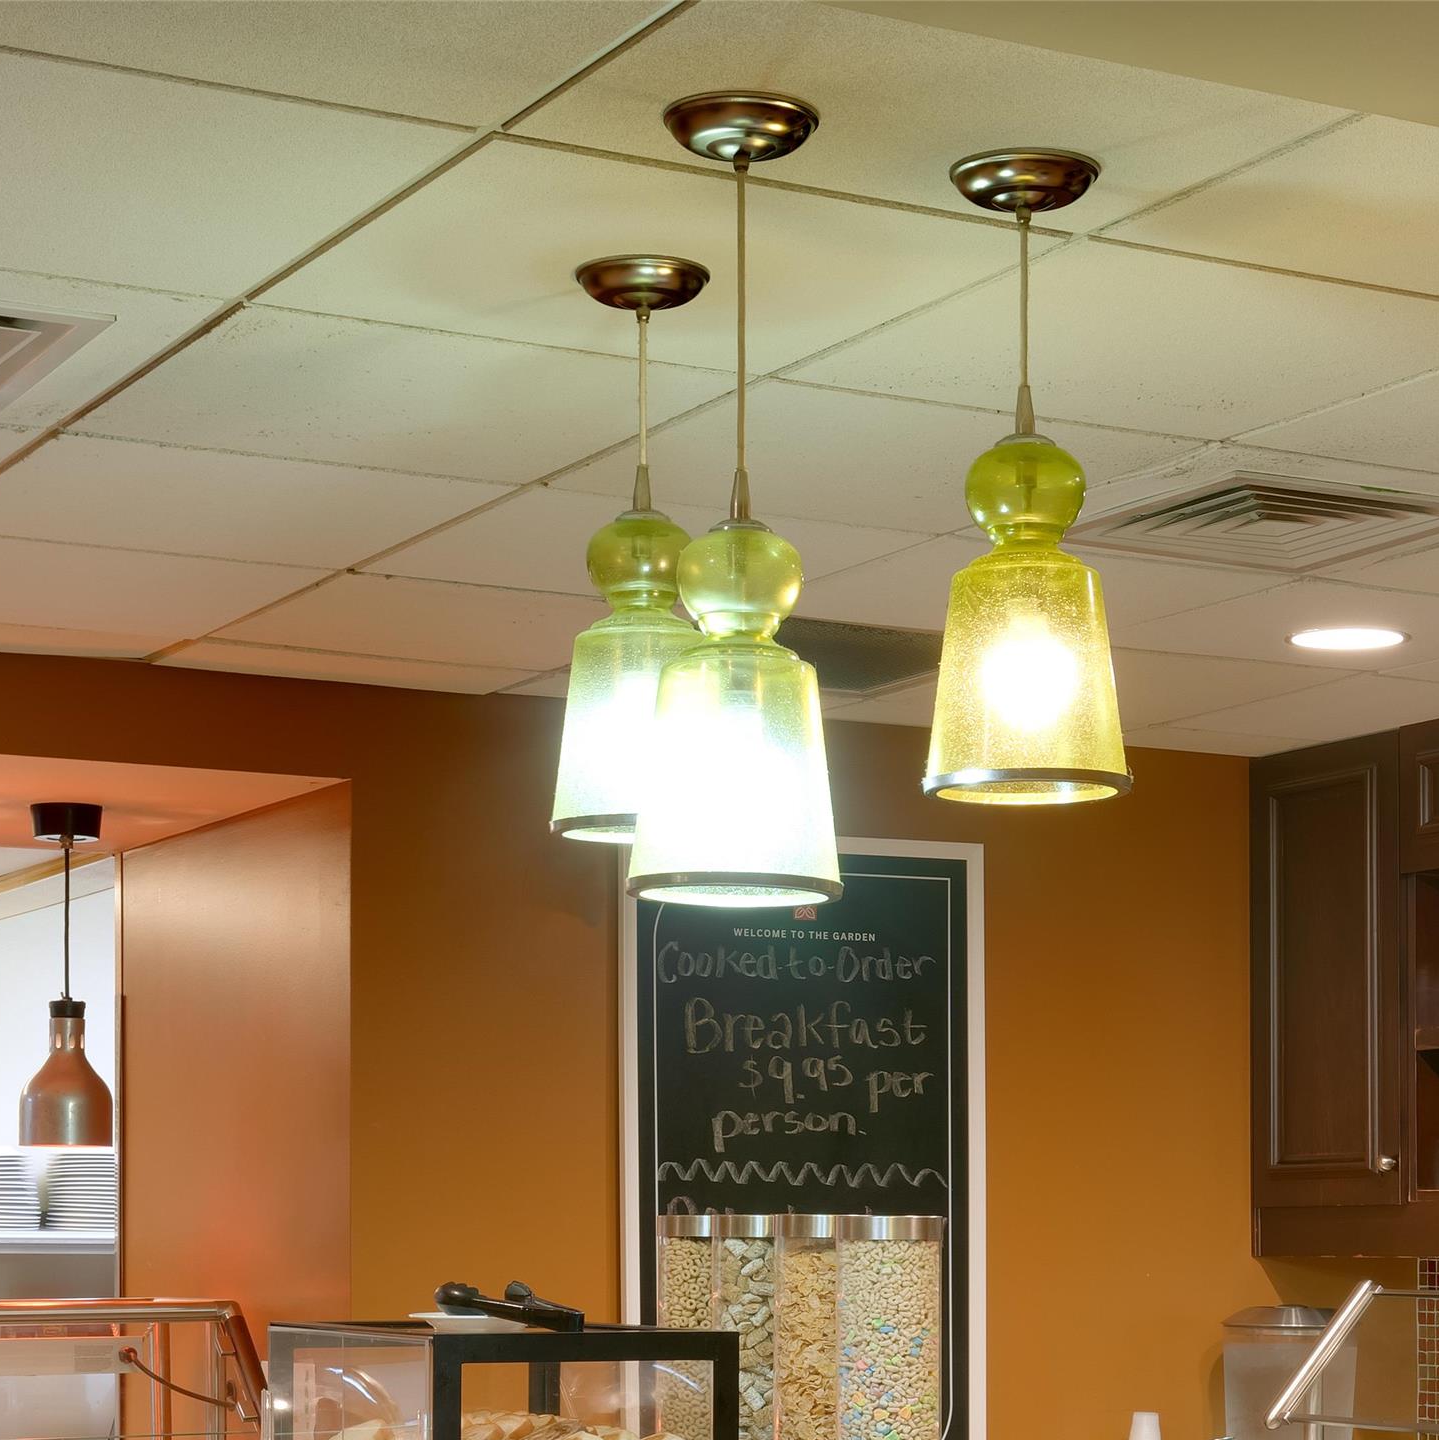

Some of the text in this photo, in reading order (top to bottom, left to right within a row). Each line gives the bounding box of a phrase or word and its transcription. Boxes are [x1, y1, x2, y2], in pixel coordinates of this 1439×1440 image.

[733, 927, 876, 942] WELCOME TO THE GARDEN
[684, 997, 928, 1054] Breakfast
[865, 1071, 935, 1113] per
